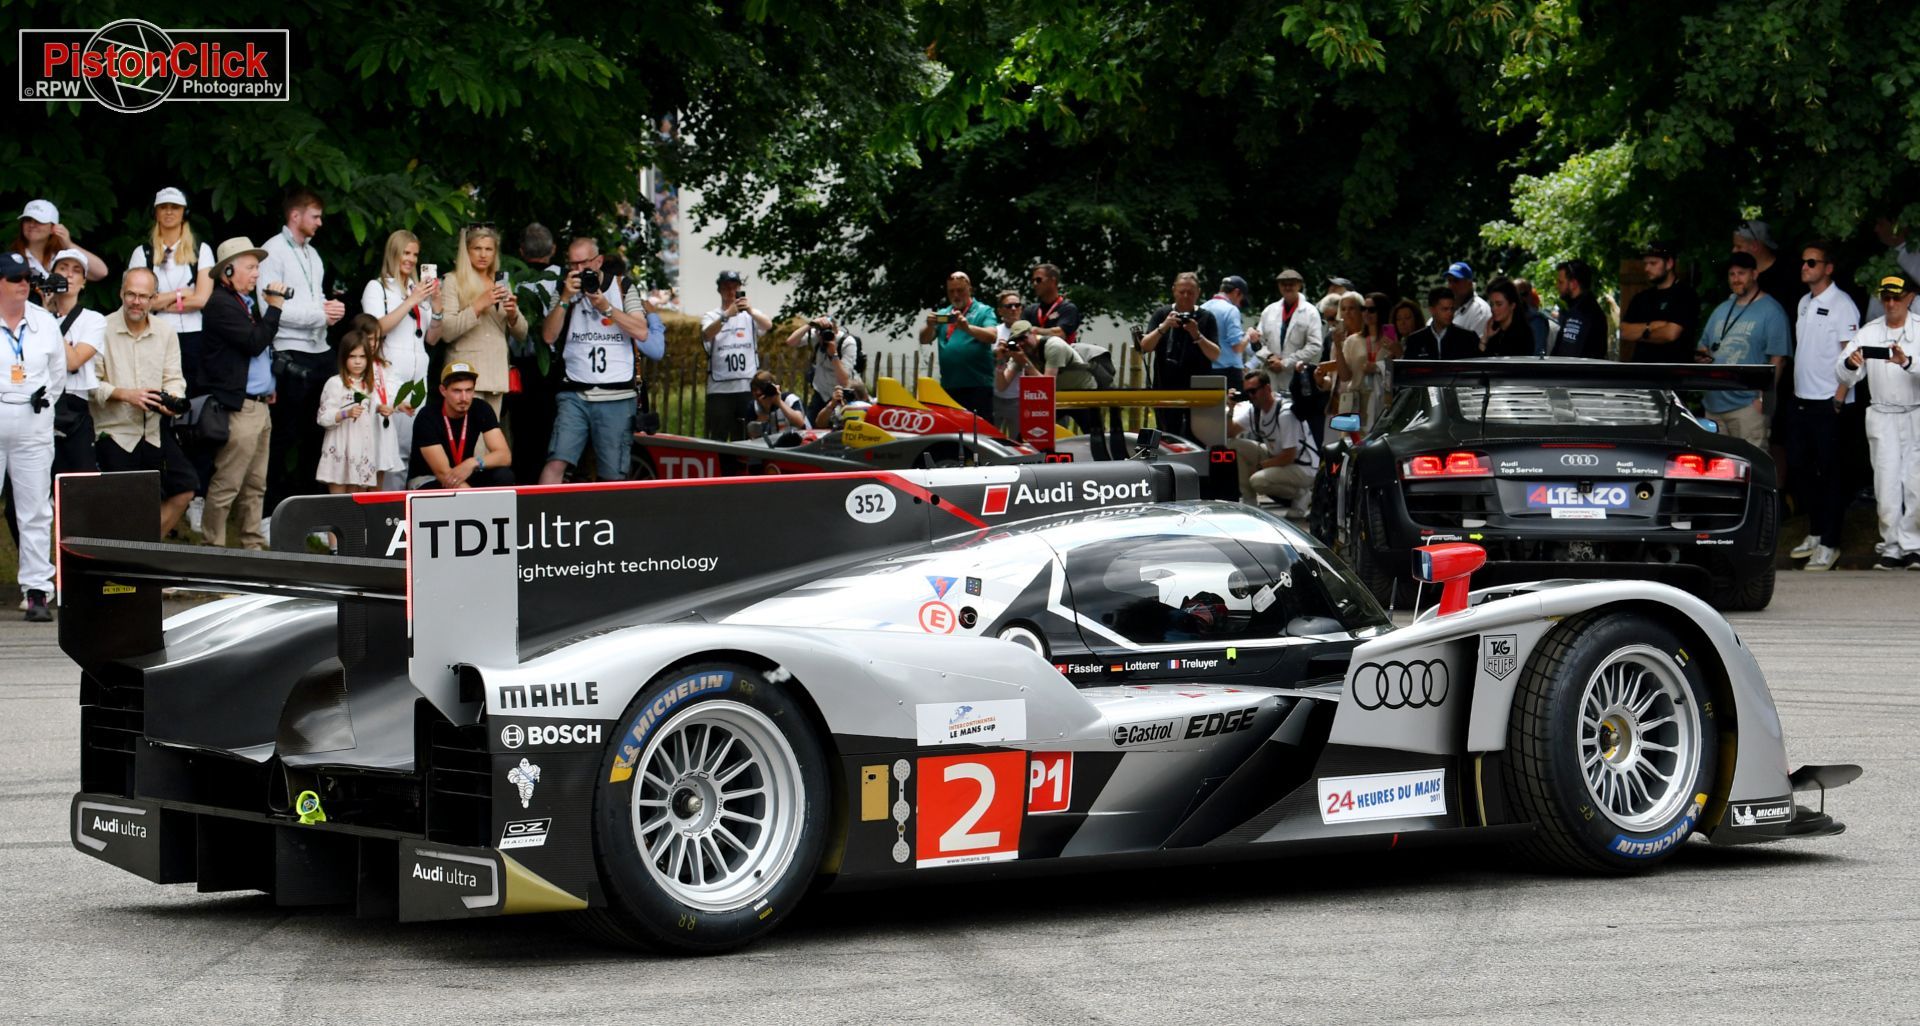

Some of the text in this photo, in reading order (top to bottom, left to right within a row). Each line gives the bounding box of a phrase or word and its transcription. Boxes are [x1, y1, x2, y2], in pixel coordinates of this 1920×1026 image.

[588, 346, 607, 374] 13
[724, 353, 746, 372] 109
[659, 456, 714, 480] TDI
[1014, 478, 1149, 504] Audi Sport
[1529, 485, 1627, 505] ALTENZO
[854, 494, 886, 514] 352
[419, 517, 510, 559] TDI
[517, 511, 615, 549] ultra
[518, 554, 719, 582] ightweight technology
[930, 609, 946, 629] E
[1491, 640, 1510, 655] TAG
[1068, 659, 1218, 674] Fässler Lotterer Treluyer
[1488, 658, 1514, 674] HEUER
[499, 681, 599, 709] MAHLE
[632, 674, 724, 742] MICHELIN
[527, 724, 602, 745] BOSCH
[949, 716, 996, 730] INTERCONTINENTAL
[949, 731, 958, 739] LE
[960, 725, 982, 736] MANS
[1128, 721, 1174, 743] Castrol
[1184, 707, 1259, 740] EDGE
[1028, 758, 1065, 804] P1
[939, 762, 1001, 852] 2
[1327, 778, 1441, 814] 24 HEURES DU MANS
[1756, 806, 1790, 818] MICHELIN
[92, 815, 147, 838] Audi ultra
[1616, 819, 1689, 855] MICHELIN
[503, 837, 544, 845] RACING
[947, 855, 991, 864] www.lemans.org
[412, 863, 477, 887] Audi ultra
